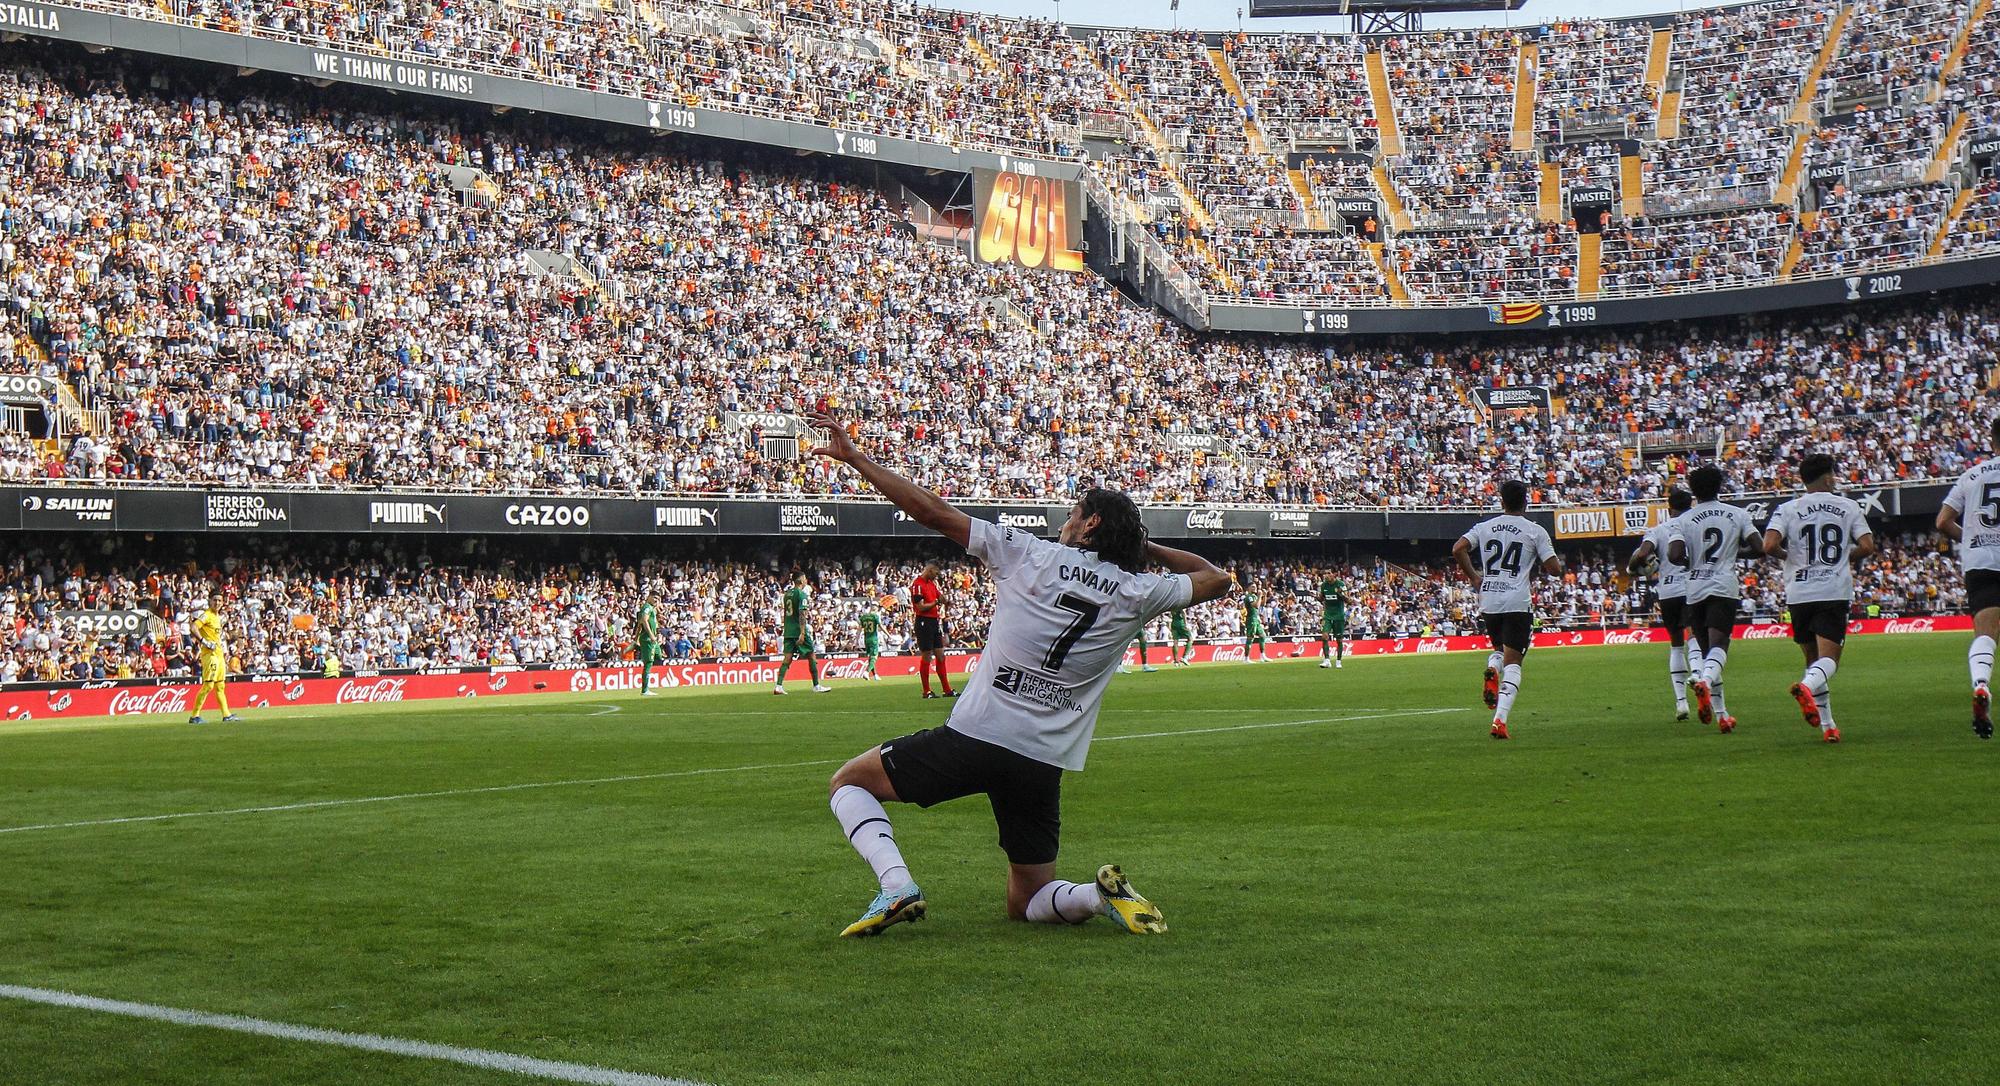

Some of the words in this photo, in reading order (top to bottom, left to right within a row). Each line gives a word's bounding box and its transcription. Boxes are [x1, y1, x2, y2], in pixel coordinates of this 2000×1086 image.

[0, 4, 60, 31] STALLA
[314, 52, 339, 74] WE
[343, 57, 393, 83] THANK
[396, 66, 427, 88] OUR
[432, 71, 473, 95] FANS!
[666, 108, 696, 128] 1979
[851, 136, 877, 155] 1980
[1013, 160, 1035, 176] 1980
[1811, 165, 1844, 179] AMSTE
[1571, 191, 1611, 203] AMSTEL
[1337, 202, 1374, 213] AMSTEL
[979, 170, 1084, 272] GOL
[1869, 275, 1902, 295] 2002
[1319, 313, 1348, 330] 1999
[1563, 305, 1597, 323] 1999
[0, 376, 41, 393] ZOO
[738, 414, 786, 428] CAZOO
[1177, 435, 1211, 447] CAZOO
[45, 498, 113, 511] SAILUN
[207, 495, 265, 508] HERRERO
[780, 505, 821, 516] HERRERO
[1979, 482, 2000, 529] 5
[76, 511, 111, 520] TYRE
[207, 507, 287, 521] BRIGANTINA
[371, 502, 424, 523] PUMA
[504, 504, 590, 526] CAZOO
[656, 507, 701, 526] PUMA
[781, 515, 836, 526] BRIGANTINA
[999, 512, 1048, 528] ŠKODA
[1280, 512, 1309, 521] SAILUN
[1691, 508, 1726, 525] THIERRY
[1725, 511, 1735, 522] R.
[1796, 510, 1808, 520] A.
[1807, 503, 1846, 519] ALMEIDA
[1557, 511, 1612, 534] CURVA
[1702, 526, 1724, 565] 2
[1799, 523, 1844, 567] 18
[1483, 538, 1524, 578] 24
[1058, 564, 1120, 597] CAVANI
[1041, 590, 1102, 675] 7
[682, 663, 780, 687] Santander
[1024, 673, 1072, 698] HERRERO
[1021, 682, 1083, 714] BRIGANTINA
